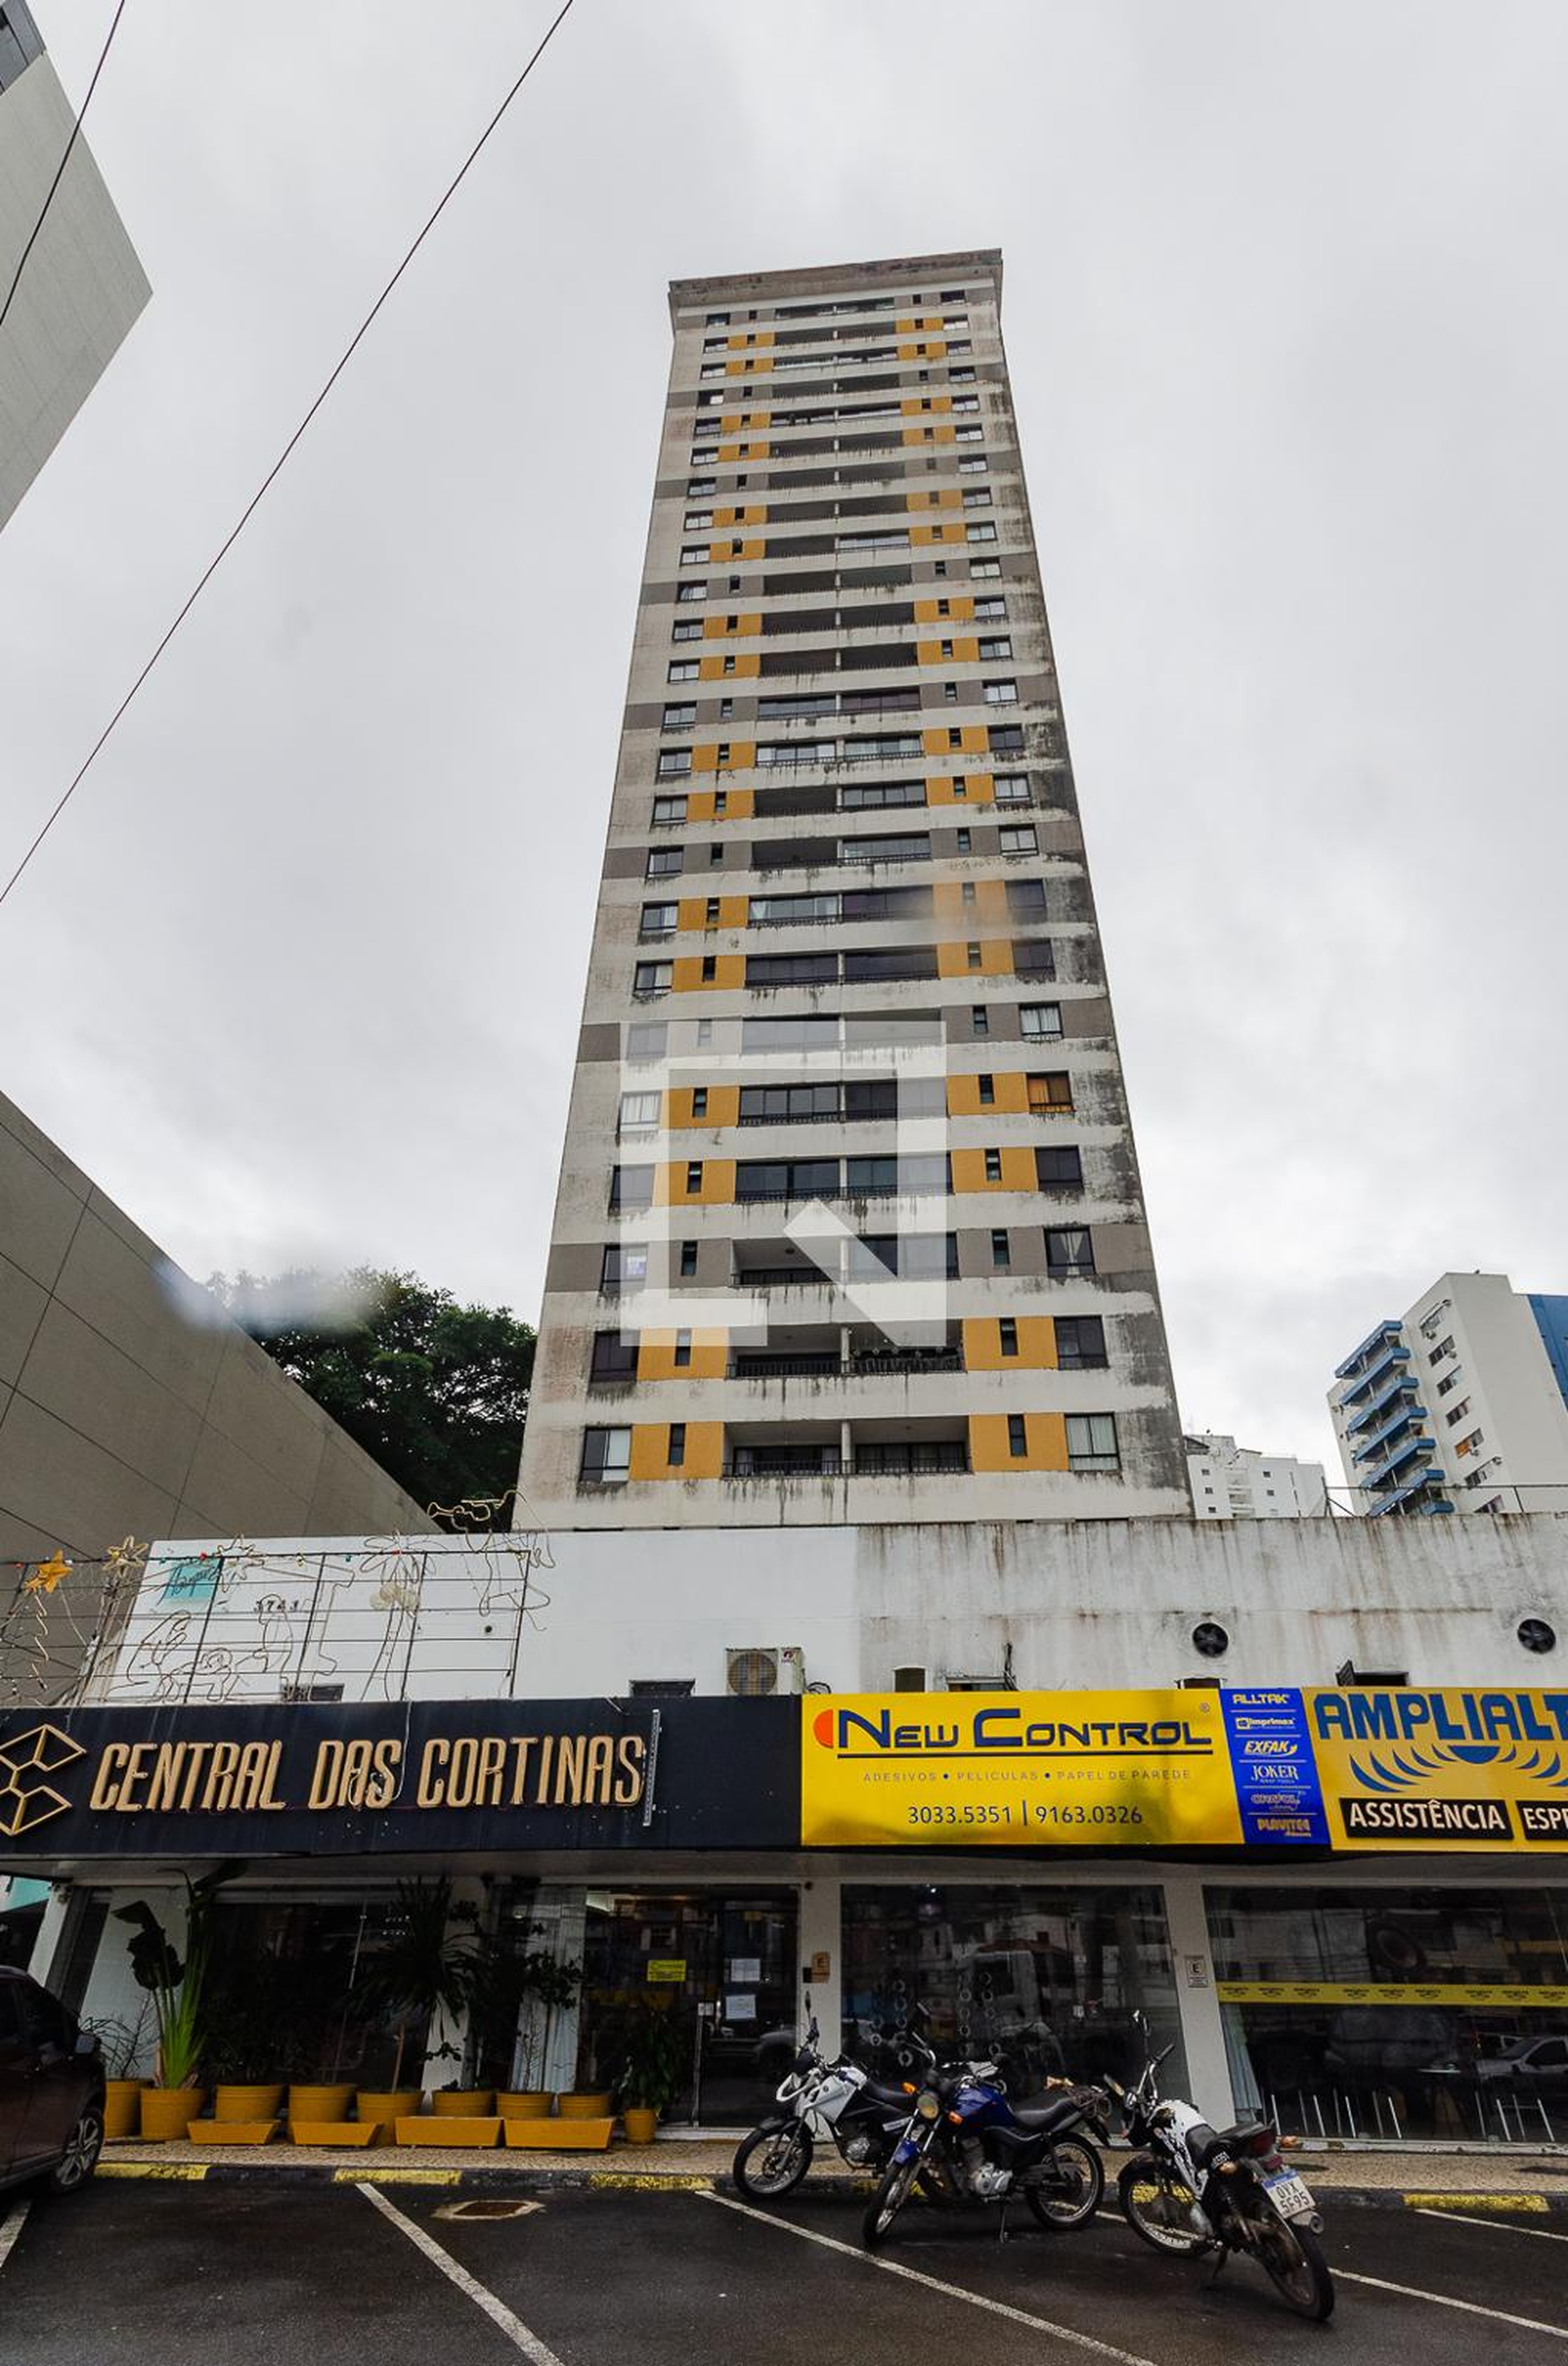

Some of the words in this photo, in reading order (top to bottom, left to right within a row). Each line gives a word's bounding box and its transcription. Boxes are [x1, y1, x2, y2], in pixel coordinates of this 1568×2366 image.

[1232, 1693, 1287, 1704] ALLTAK
[1245, 1740, 1289, 1754] EXFAK
[89, 1740, 285, 1811] CENTRAL
[308, 1740, 402, 1810] DAS
[416, 1736, 645, 1809] CORTINAS
[1251, 1766, 1299, 1781] JOKER
[908, 1806, 1012, 1825] 3033.5351
[1036, 1805, 1142, 1825] 9163.0326
[1350, 1800, 1505, 1830] ASSISTÊNCIA
